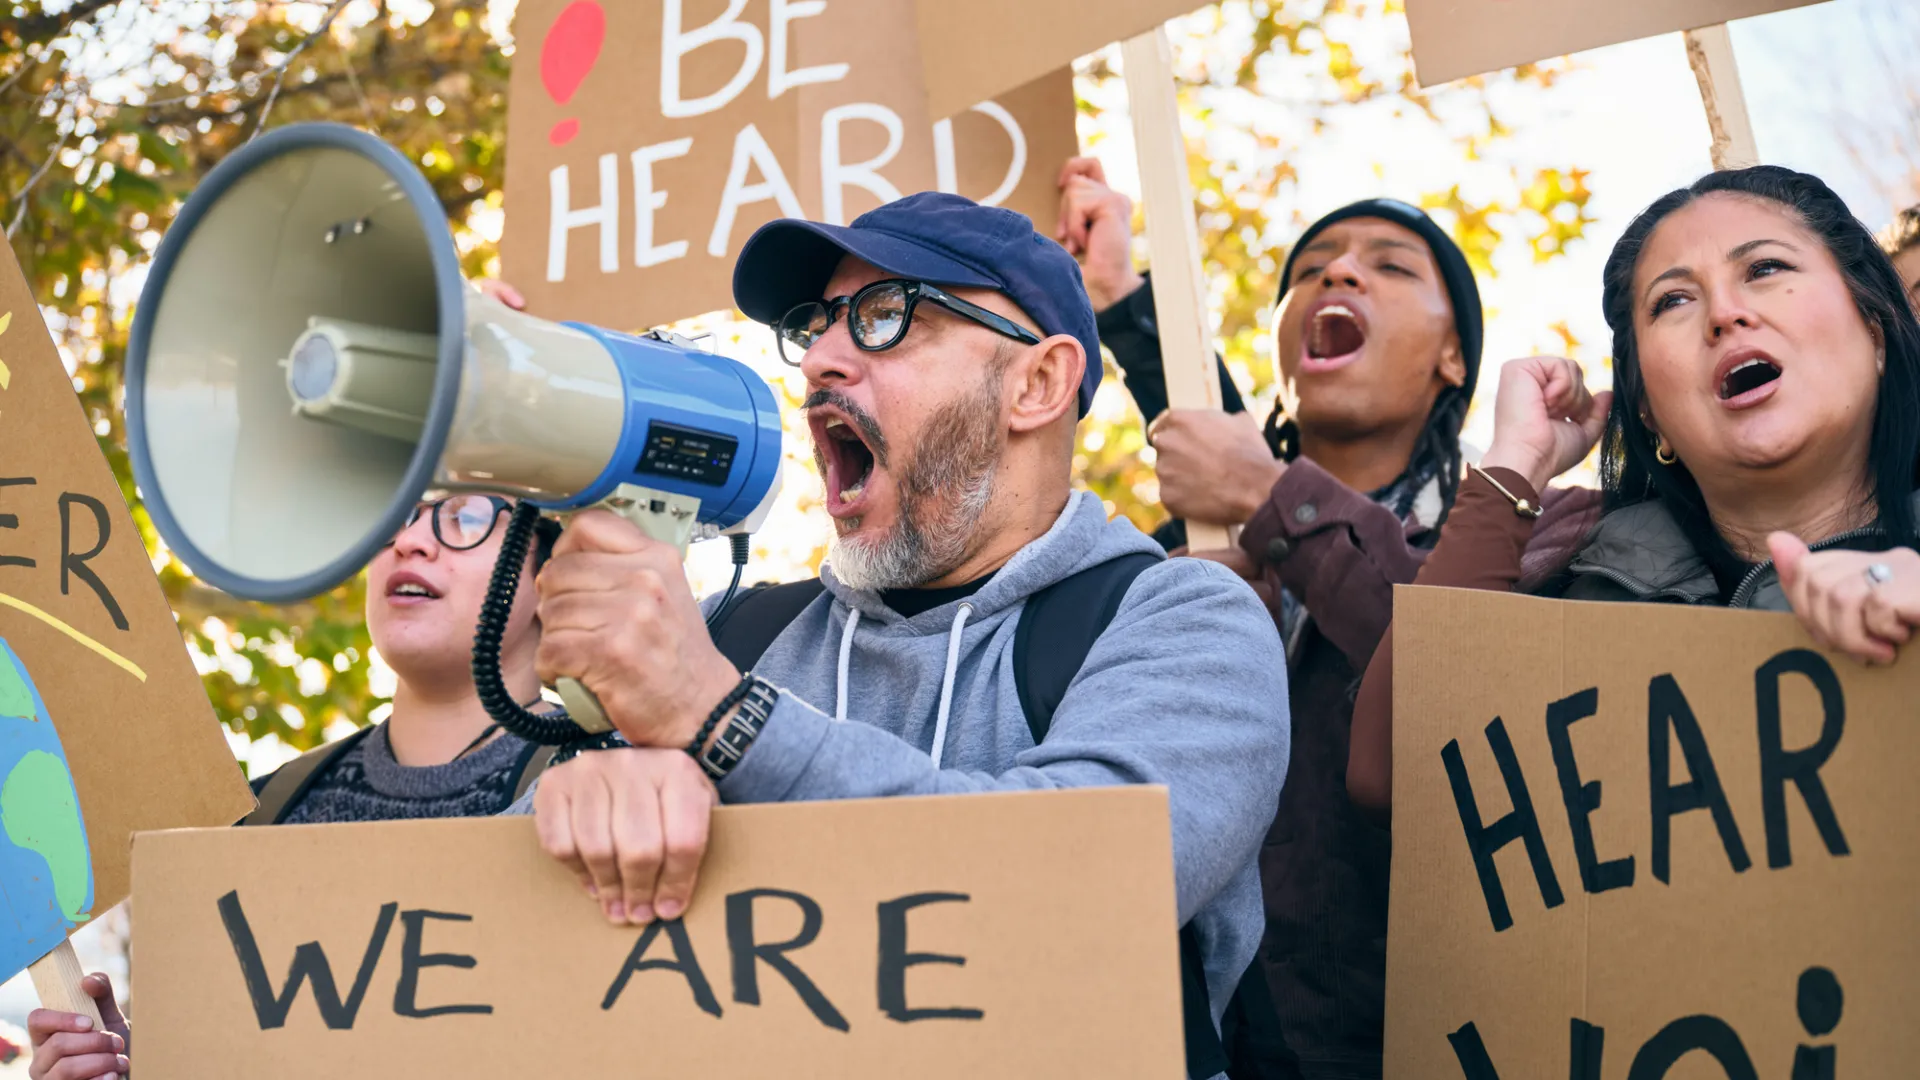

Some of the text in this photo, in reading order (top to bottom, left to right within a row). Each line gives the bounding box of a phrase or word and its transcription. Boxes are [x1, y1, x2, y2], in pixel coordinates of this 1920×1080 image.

[546, 100, 1027, 282] HEARD
[1440, 648, 1852, 933] HEAR
[217, 888, 985, 1033] WE ARE
